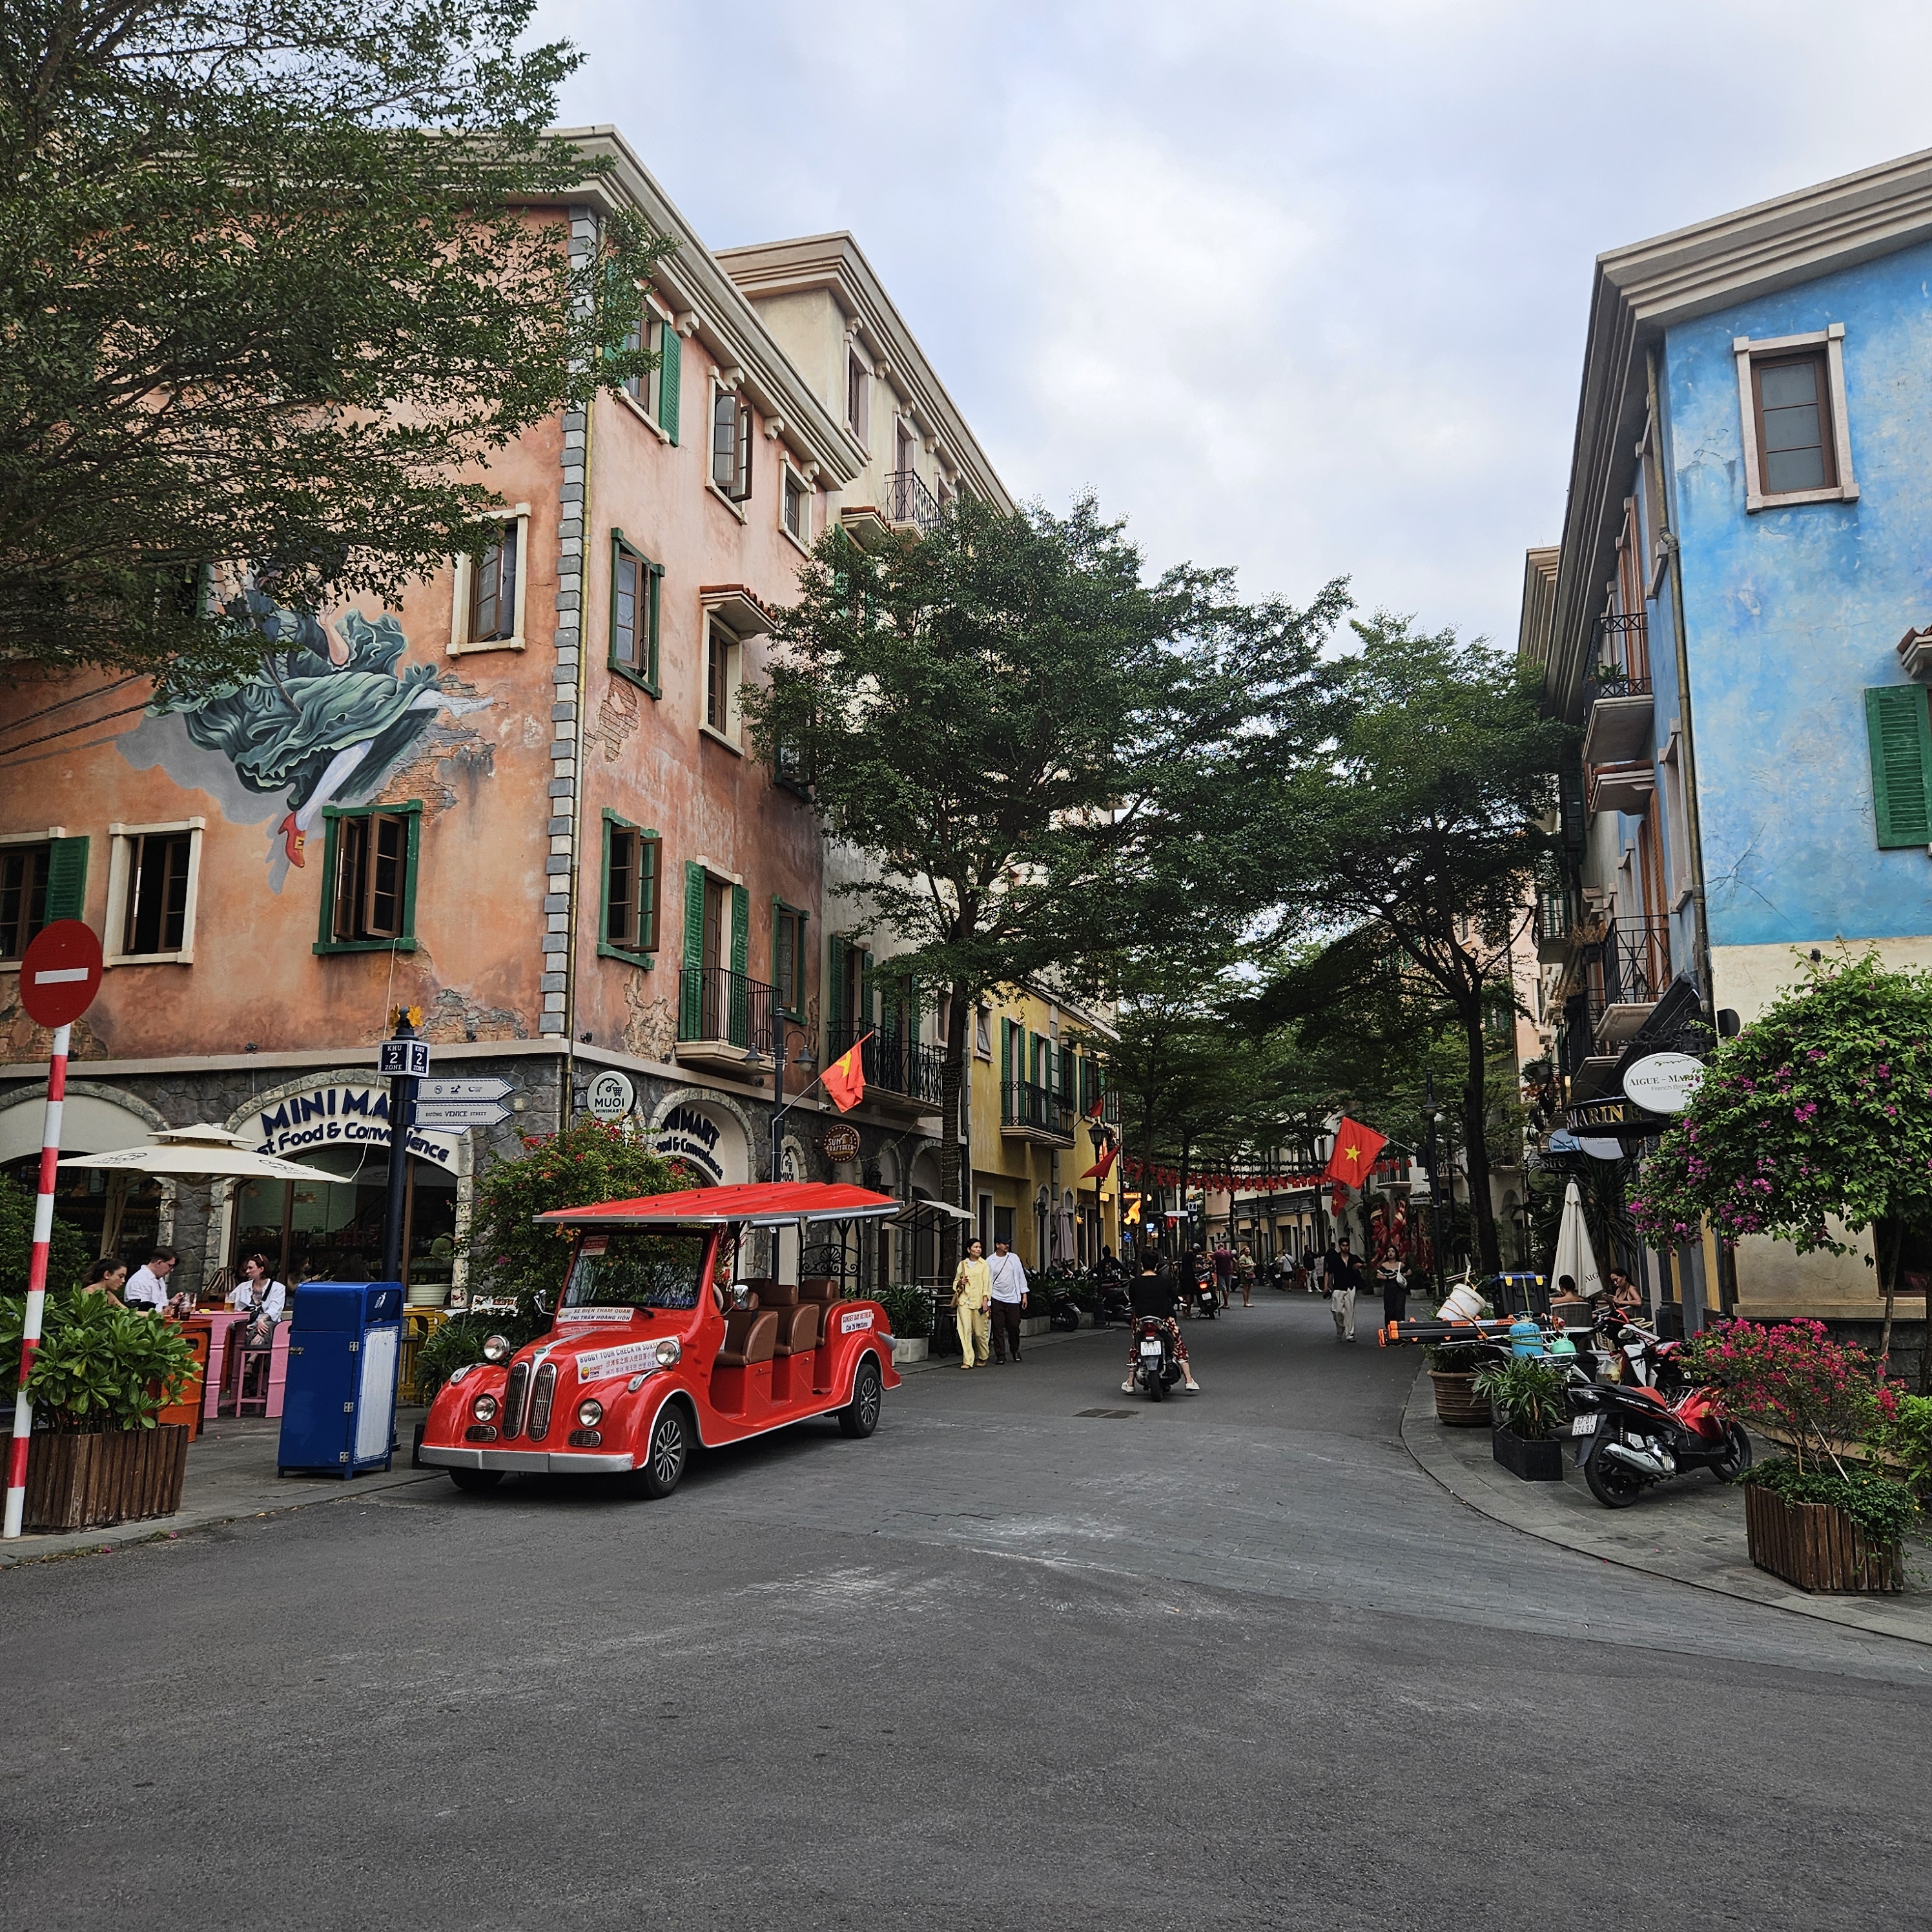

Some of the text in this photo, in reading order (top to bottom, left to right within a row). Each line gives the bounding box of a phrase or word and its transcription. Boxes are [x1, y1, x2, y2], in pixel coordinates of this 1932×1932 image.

[390, 1052, 398, 1064] 2
[416, 1053, 422, 1065] 2
[1629, 1077, 1660, 1086] AIGUE
[595, 1098, 624, 1107] MUOI
[260, 1089, 336, 1136] MINI
[1567, 1104, 1642, 1131] MARINE
[278, 1124, 324, 1151] Food
[327, 1122, 341, 1138] &
[657, 1136, 672, 1153] ood
[579, 1353, 598, 1363] BUGGY
[599, 1350, 615, 1359] TOUR
[616, 1346, 635, 1355] CHECK
